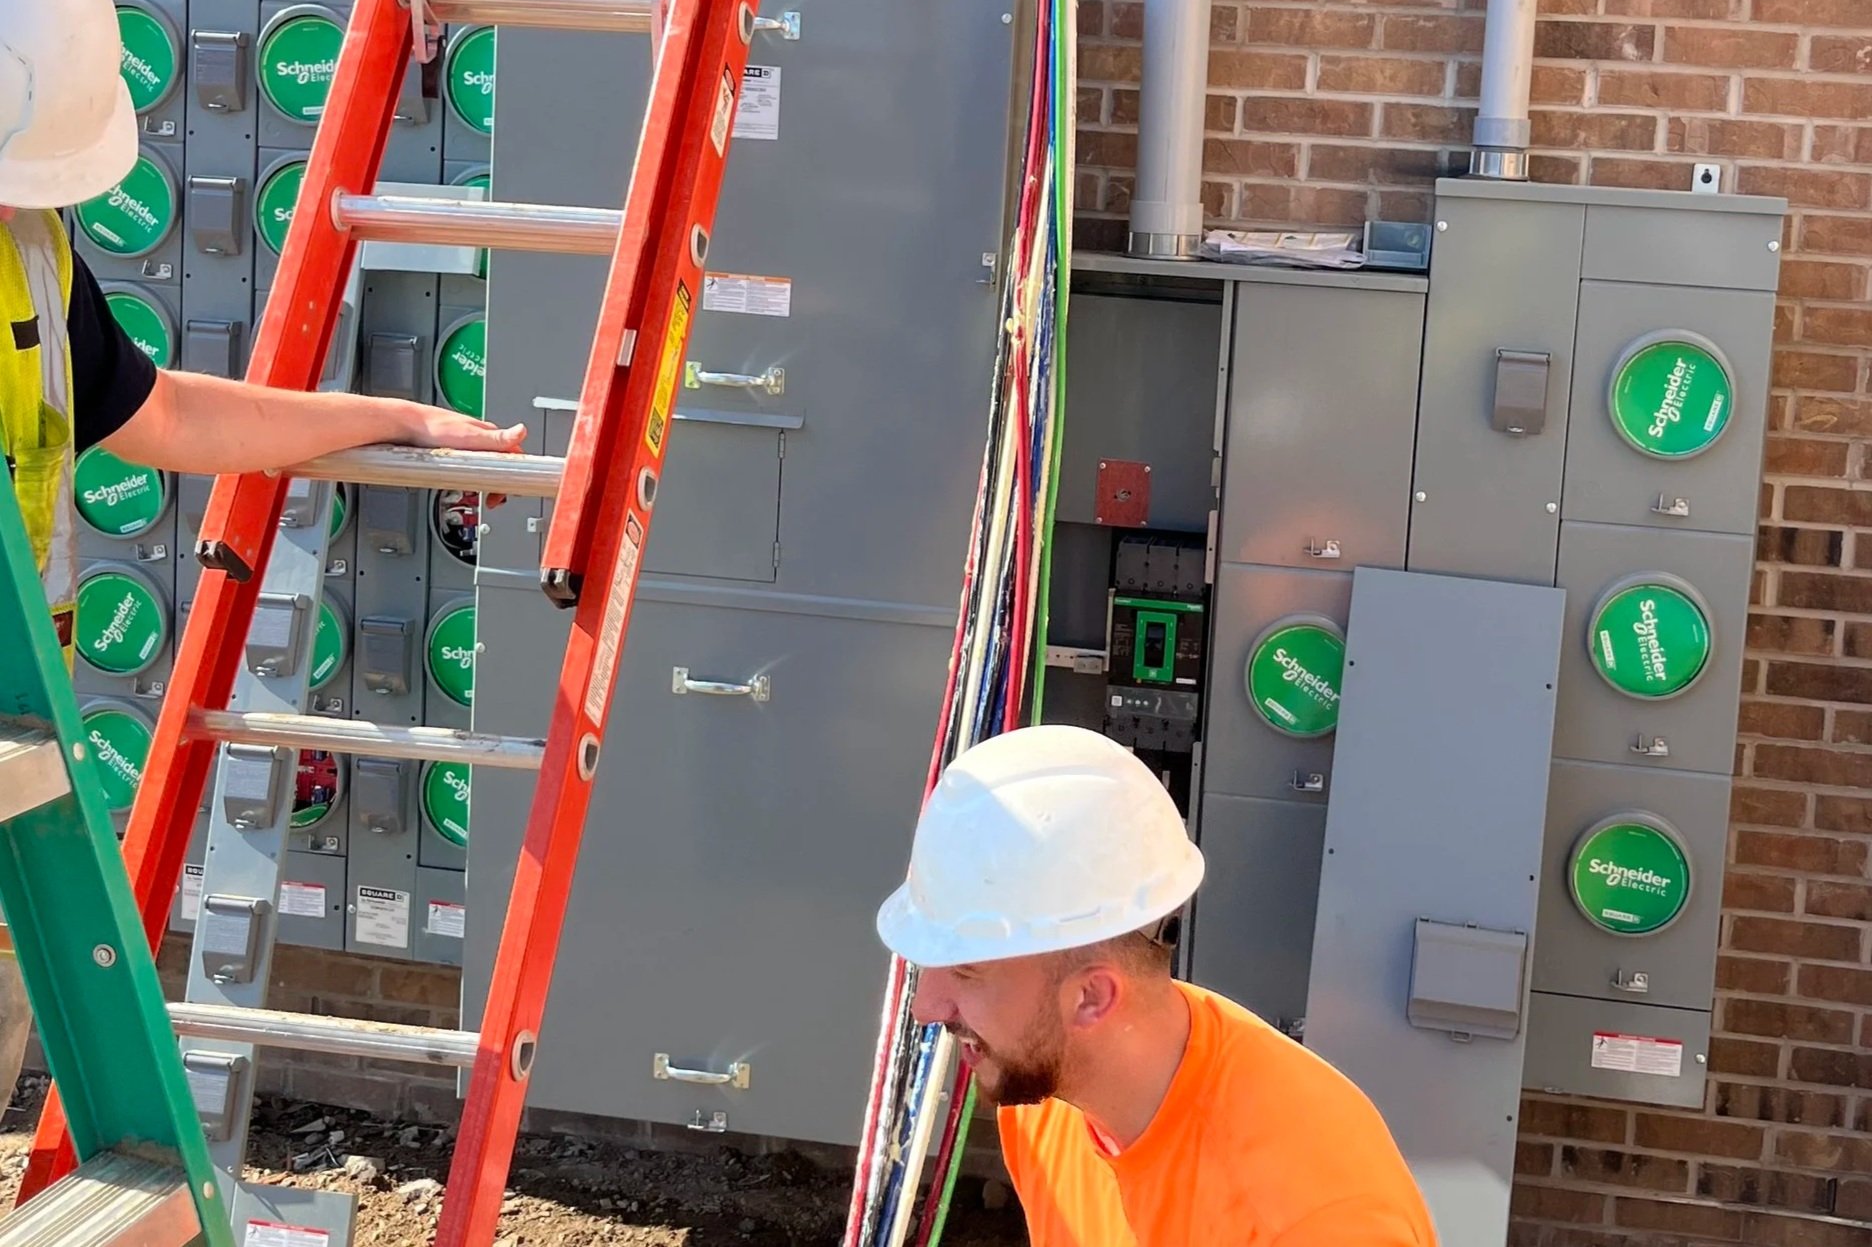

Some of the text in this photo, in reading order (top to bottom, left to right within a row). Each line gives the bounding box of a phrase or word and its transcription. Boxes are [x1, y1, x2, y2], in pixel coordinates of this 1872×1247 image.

[122, 61, 154, 93] Electric
[276, 59, 337, 76] Schneid
[310, 73, 331, 83] Elec
[120, 203, 153, 233] Electric
[1648, 357, 1687, 438] Schneider
[1673, 363, 1696, 408] Electric
[83, 474, 148, 504] Schneider
[119, 485, 150, 501] Electric
[94, 592, 135, 652] Schneider
[121, 600, 142, 633] Electric
[1639, 599, 1667, 681] Schneider
[1273, 648, 1341, 702] Schneider
[1638, 637, 1654, 682] Electric
[1294, 678, 1333, 711] Electric
[1588, 858, 1671, 888] Schneider
[1621, 878, 1667, 897] Electric
[361, 889, 394, 899] SQUARE
